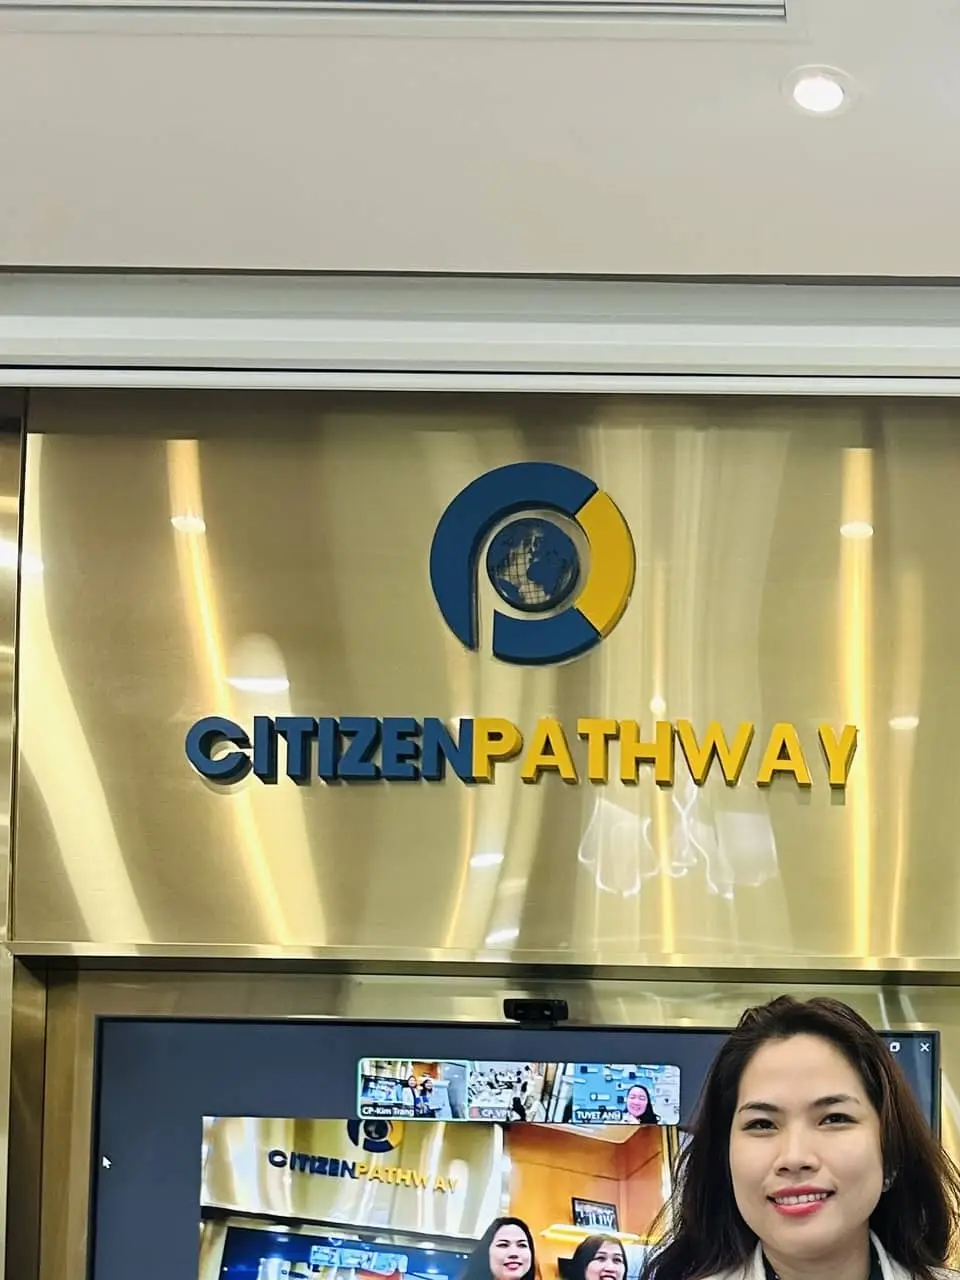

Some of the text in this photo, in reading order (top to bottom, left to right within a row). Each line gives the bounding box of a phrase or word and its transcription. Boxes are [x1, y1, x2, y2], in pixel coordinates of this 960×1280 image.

[362, 1107, 414, 1117] CP-Kim Trang
[602, 1111, 620, 1120] ANH
